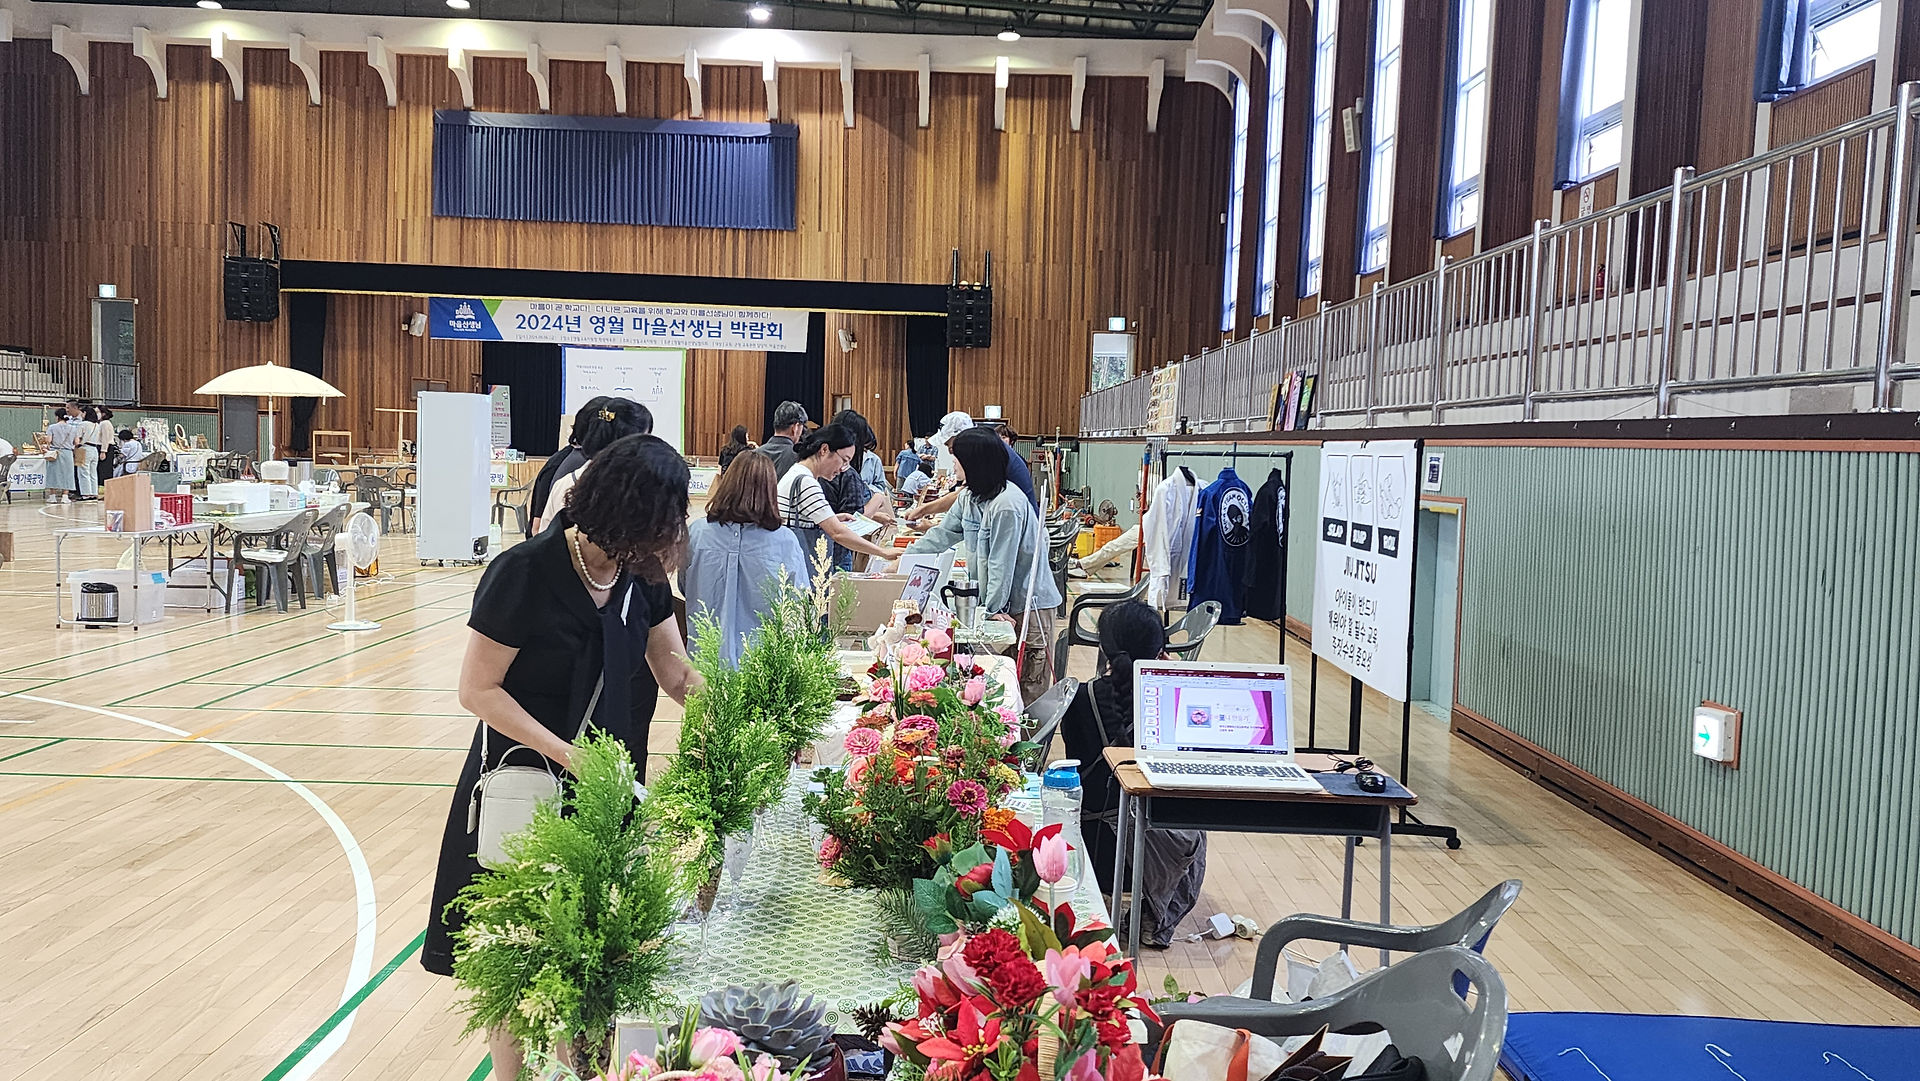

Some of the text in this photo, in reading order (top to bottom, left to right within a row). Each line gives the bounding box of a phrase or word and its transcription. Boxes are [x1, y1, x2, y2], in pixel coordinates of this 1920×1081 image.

[515, 314, 784, 341] 2024년 영월 마을선생님 박람회
[530, 303, 553, 311] 마을이
[595, 305, 604, 313] 더
[605, 306, 621, 314] 나은
[623, 306, 646, 315] 교육을
[648, 307, 663, 316] 위해
[665, 308, 688, 317] 학교와
[691, 309, 736, 318] 마을선생님이
[1335, 587, 1378, 622] 아이들이 반드시
[1328, 609, 1347, 635] 배워야
[1355, 620, 1366, 643] 필수
[1332, 635, 1373, 673] 주짓수의 중요성
